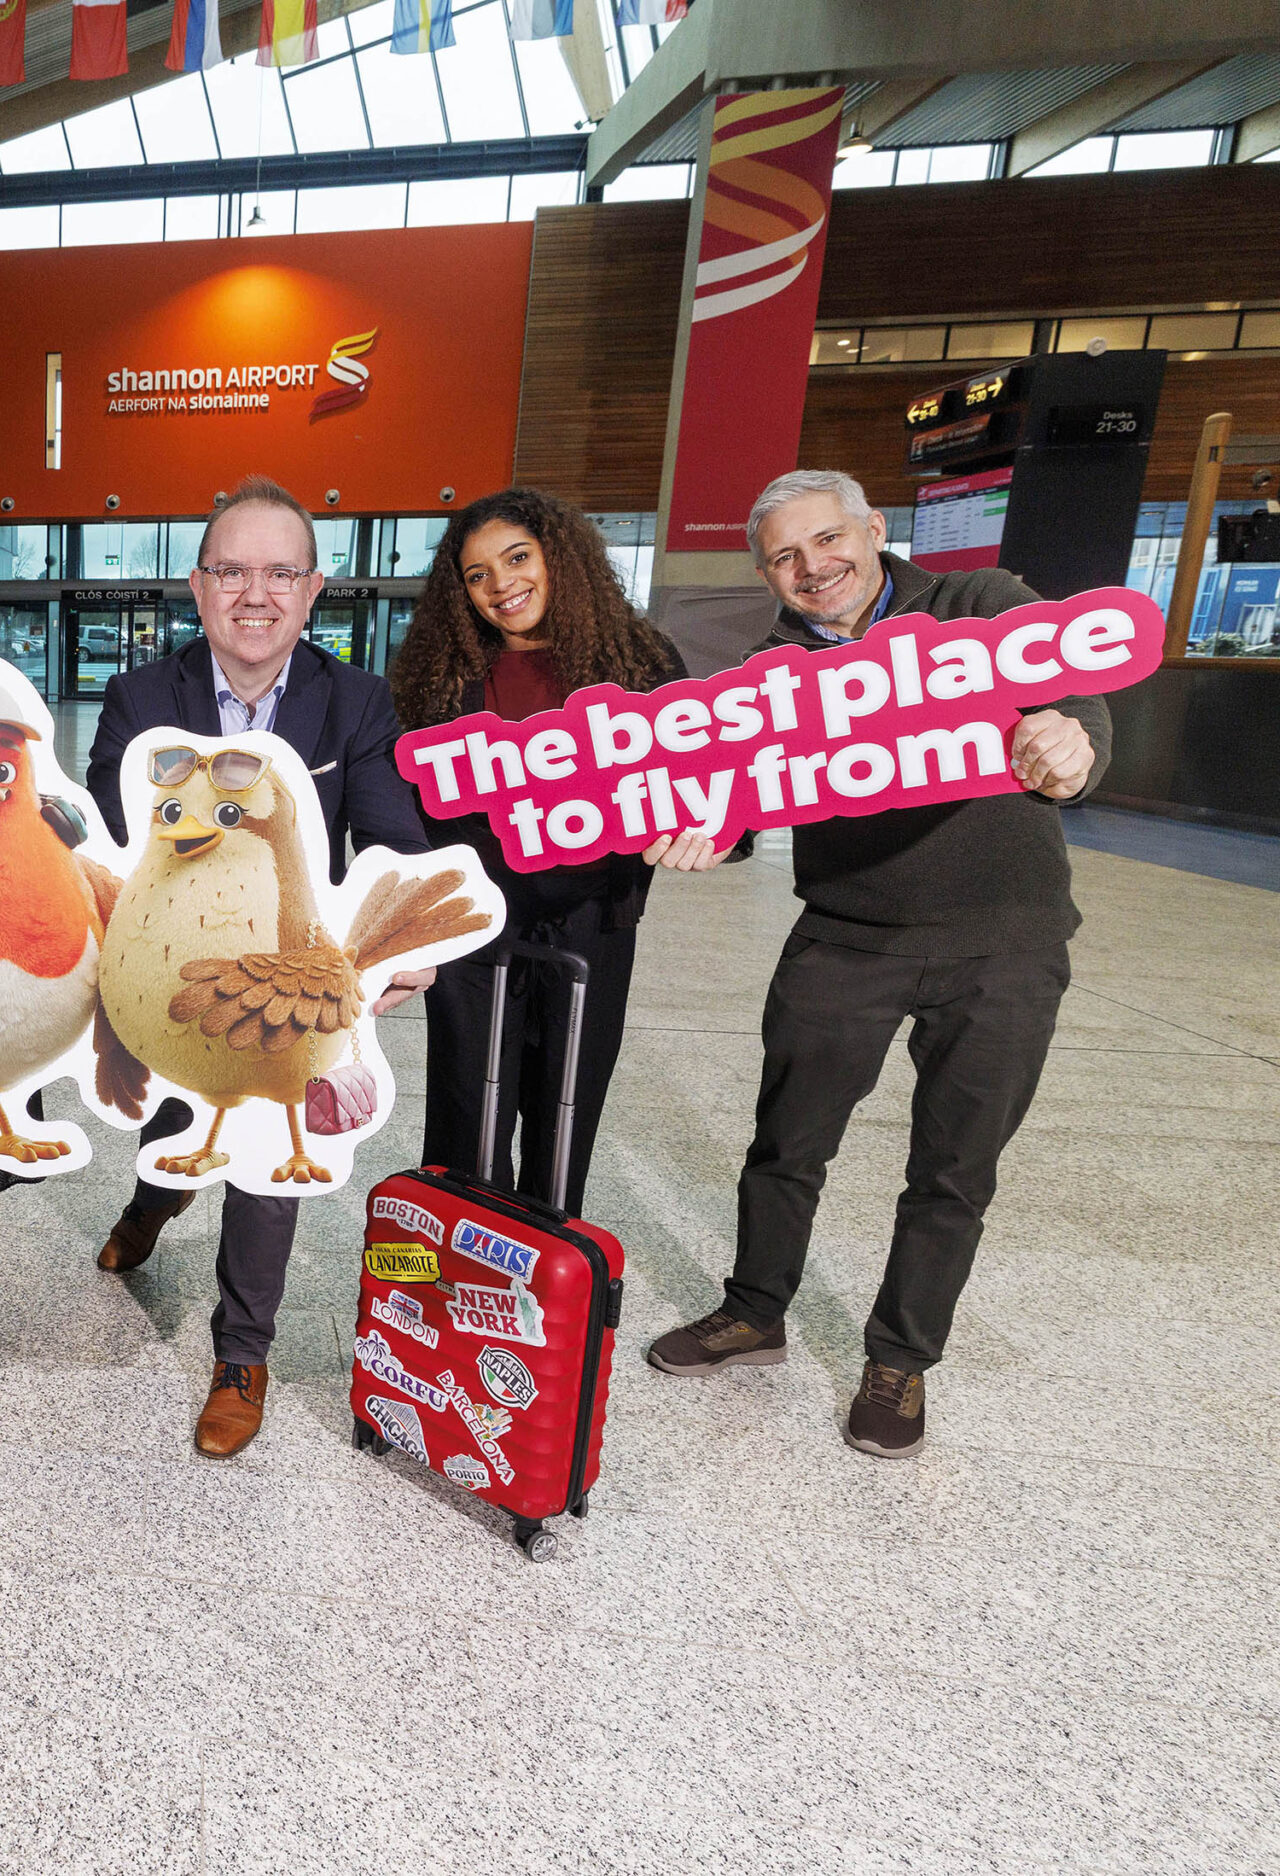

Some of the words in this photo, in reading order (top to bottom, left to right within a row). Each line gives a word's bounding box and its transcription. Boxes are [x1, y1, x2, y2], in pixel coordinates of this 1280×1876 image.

[107, 367, 221, 393] shannon
[225, 364, 319, 388] AIRPORT
[108, 397, 165, 412] AERFORT
[168, 398, 187, 409] NA
[189, 391, 269, 410] sionainne
[1096, 420, 1137, 433] 21-30
[684, 523, 726, 532] shannon
[142, 591, 150, 600] 2
[326, 588, 357, 598] PARK
[360, 588, 369, 598] 2
[414, 726, 577, 803] The
[585, 664, 801, 768] best
[818, 608, 1137, 739] place
[508, 799, 604, 858] to
[612, 769, 734, 841] fly
[747, 721, 1007, 807] from
[375, 1200, 441, 1241] BOSTON
[368, 1254, 437, 1273] LANZAROTE
[456, 1229, 527, 1276] PARIS
[458, 1288, 517, 1314] NEW
[373, 1299, 436, 1346] LONDON
[451, 1306, 522, 1336] YORK
[371, 1359, 445, 1407] CORFU
[483, 1352, 533, 1402] NAPLES
[367, 1396, 427, 1465] CHICAGO
[440, 1373, 513, 1480] BARCELONA
[447, 1469, 486, 1481] PORTO
